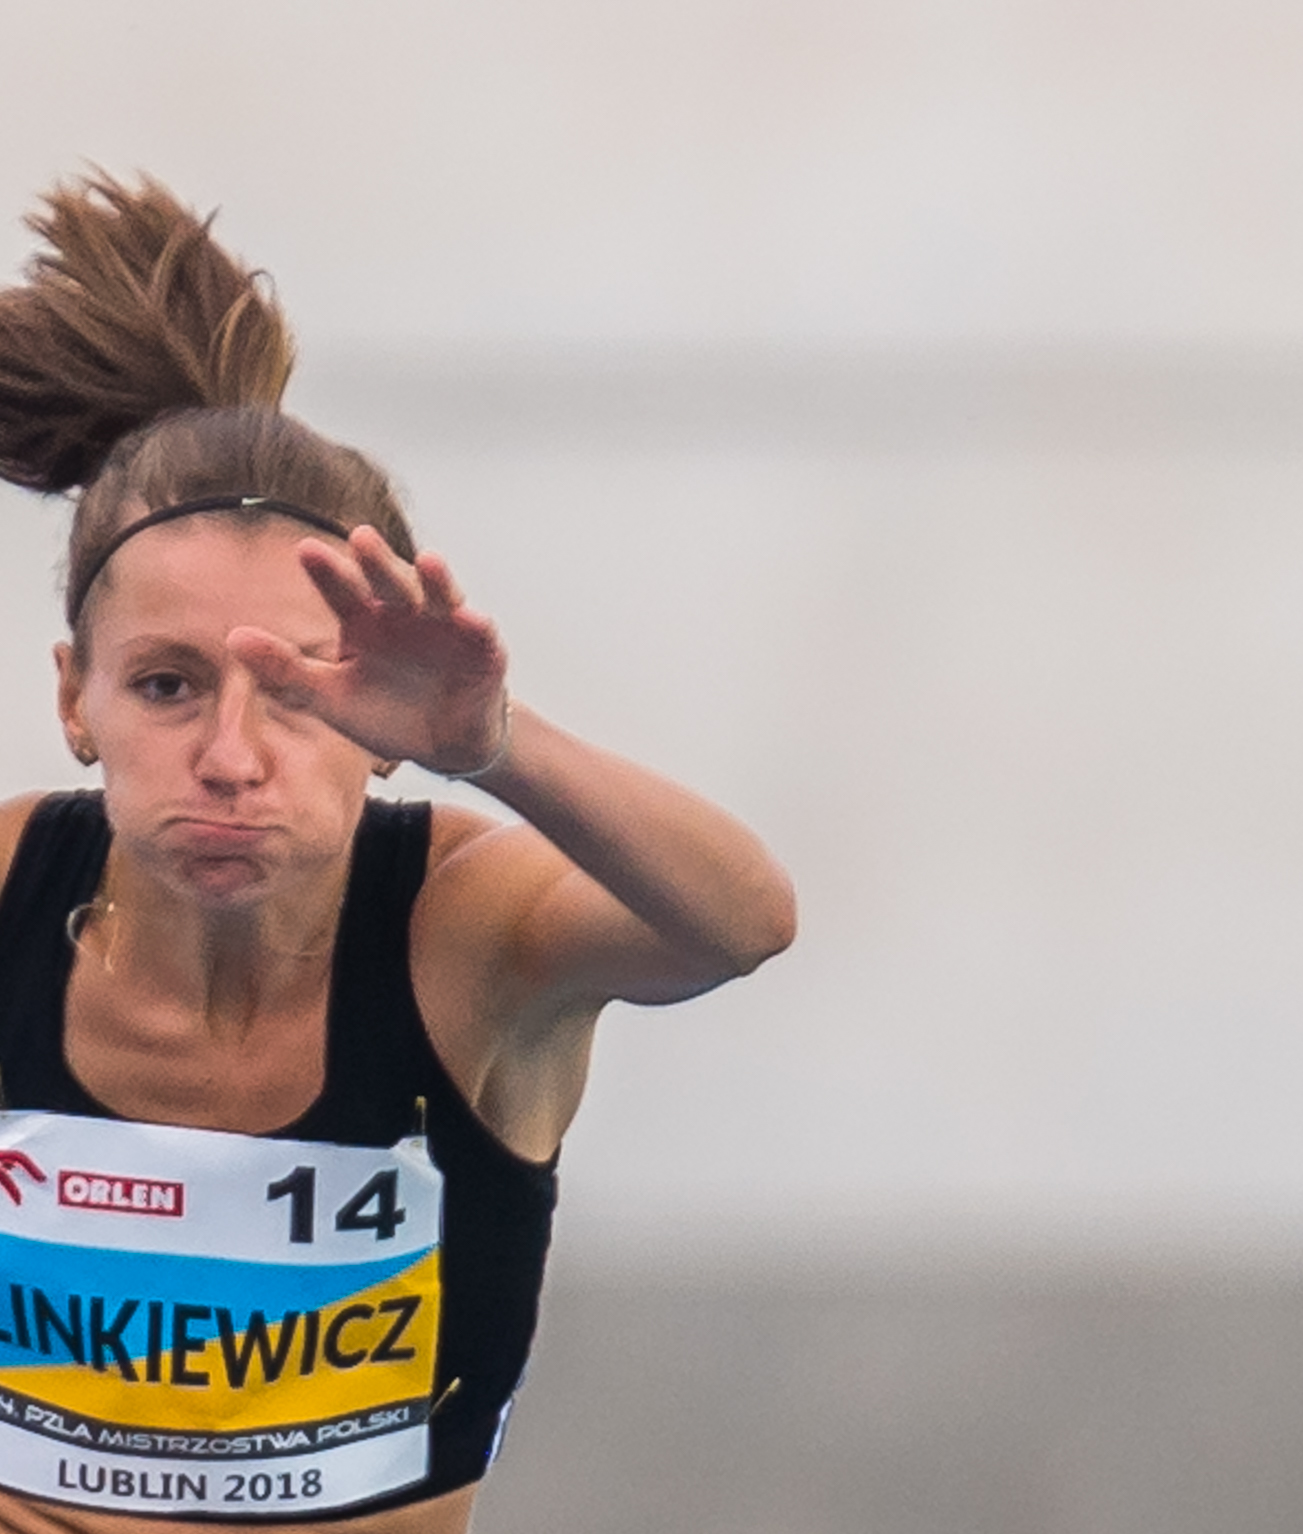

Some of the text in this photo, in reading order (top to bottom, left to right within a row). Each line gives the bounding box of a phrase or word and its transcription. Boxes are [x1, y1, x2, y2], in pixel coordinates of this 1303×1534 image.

[63, 1174, 178, 1212] ORLEN
[266, 1165, 407, 1244] 14
[24, 1404, 93, 1441] PZLA
[98, 1428, 311, 1454] MISTRZOSTWA
[316, 1406, 410, 1444] POLSKI
[58, 1458, 323, 1502] LUBLIN 2018
